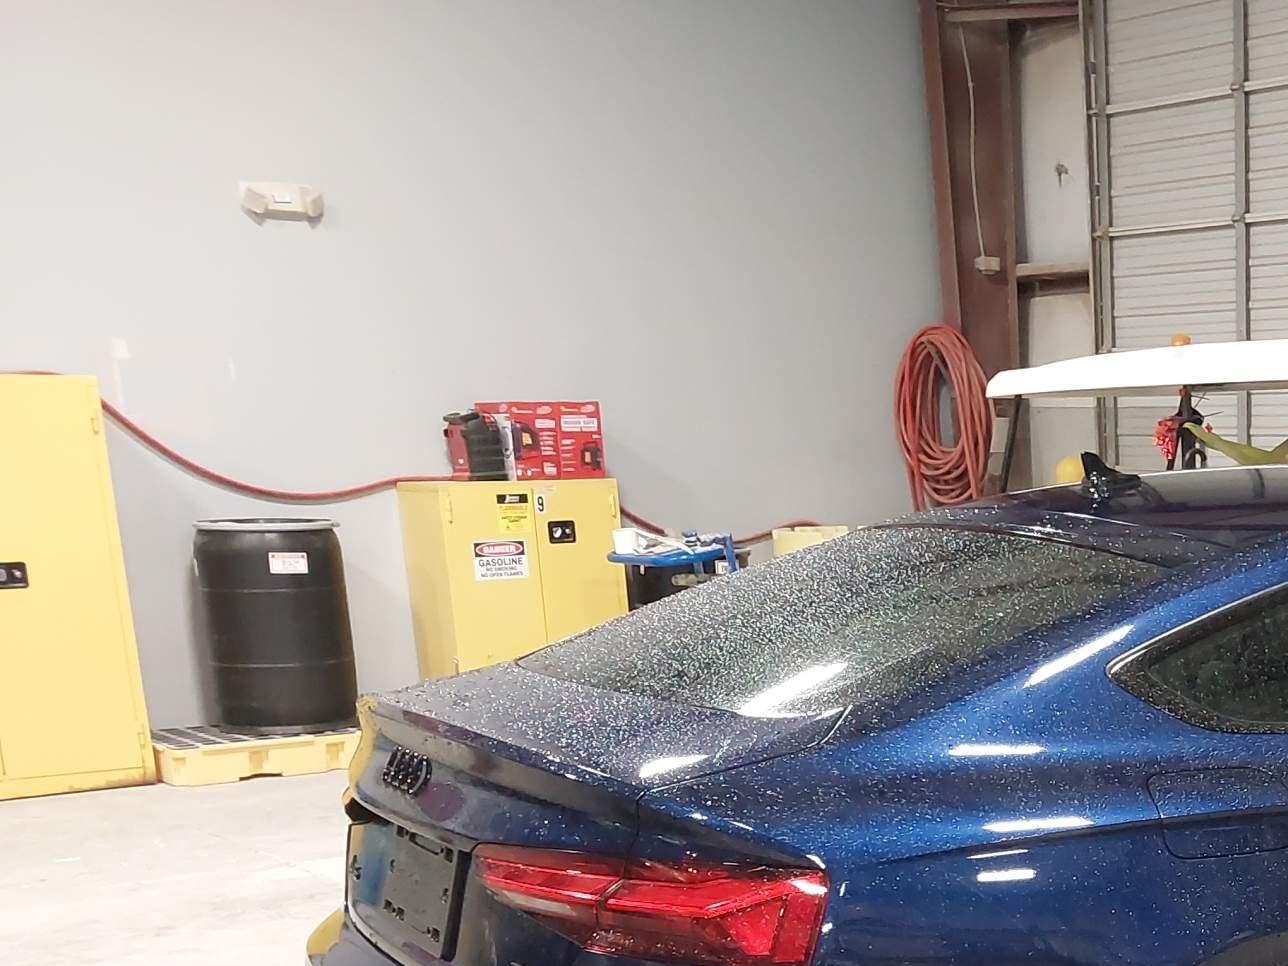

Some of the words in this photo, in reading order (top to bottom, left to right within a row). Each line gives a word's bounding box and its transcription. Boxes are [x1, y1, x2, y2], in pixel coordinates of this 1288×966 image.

[537, 496, 545, 512] 9
[482, 544, 517, 554] DANGER
[478, 557, 524, 567] GASOLINE
